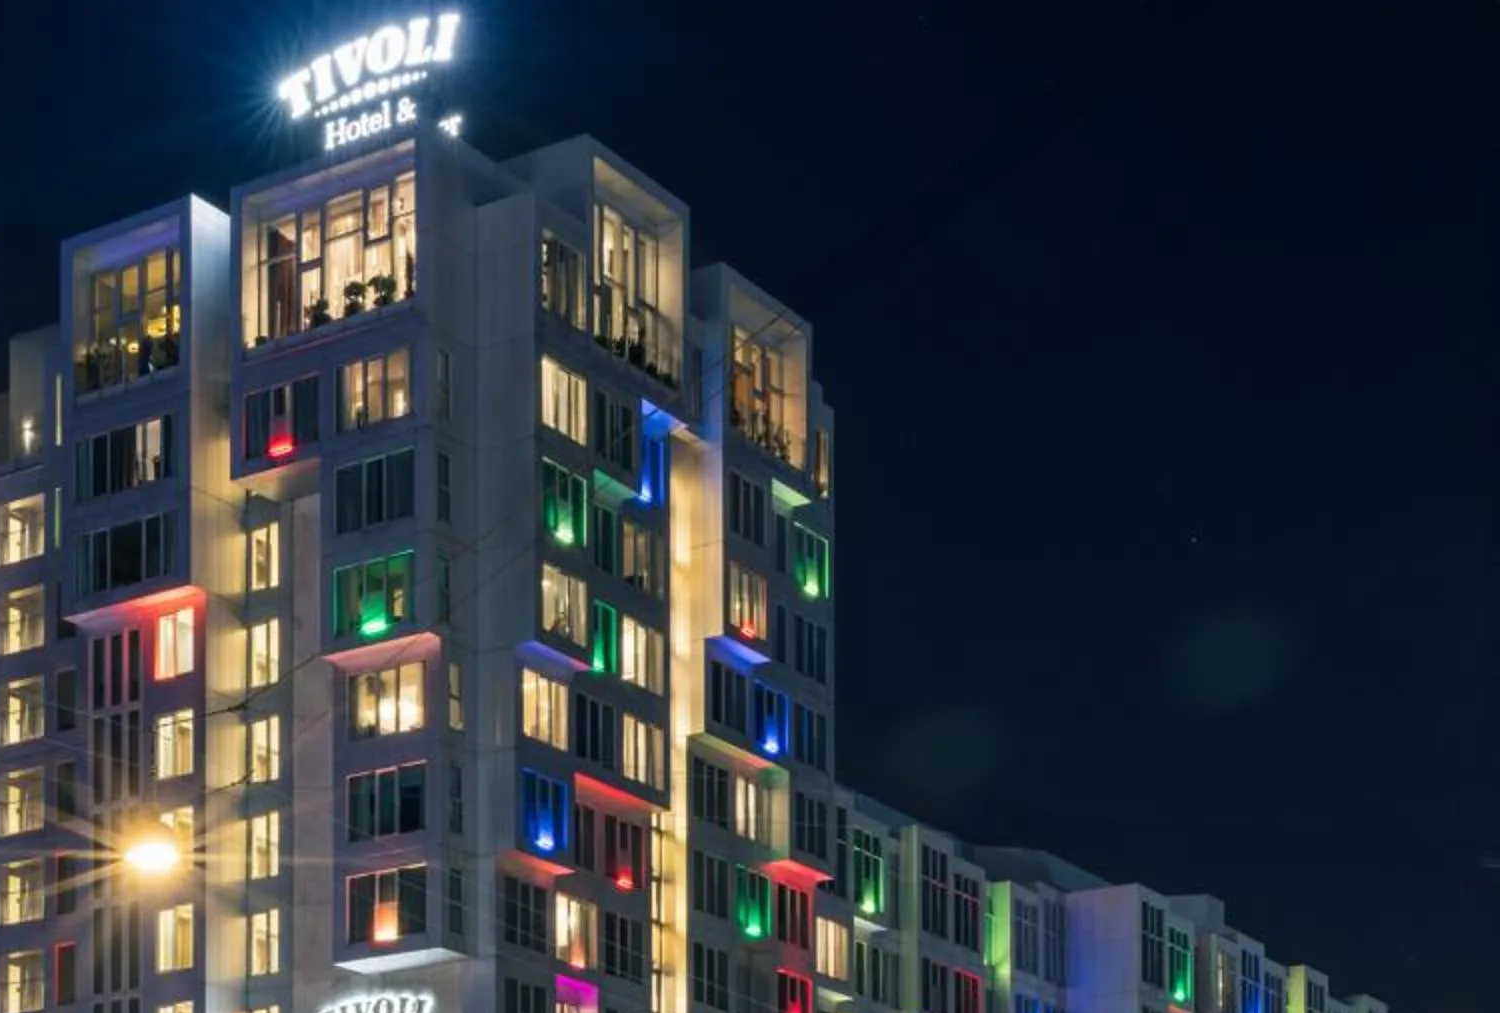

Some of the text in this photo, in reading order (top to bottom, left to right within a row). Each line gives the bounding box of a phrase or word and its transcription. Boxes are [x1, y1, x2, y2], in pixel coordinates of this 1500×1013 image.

[278, 13, 461, 119] TIVOLI
[324, 97, 416, 150] Hotel &
